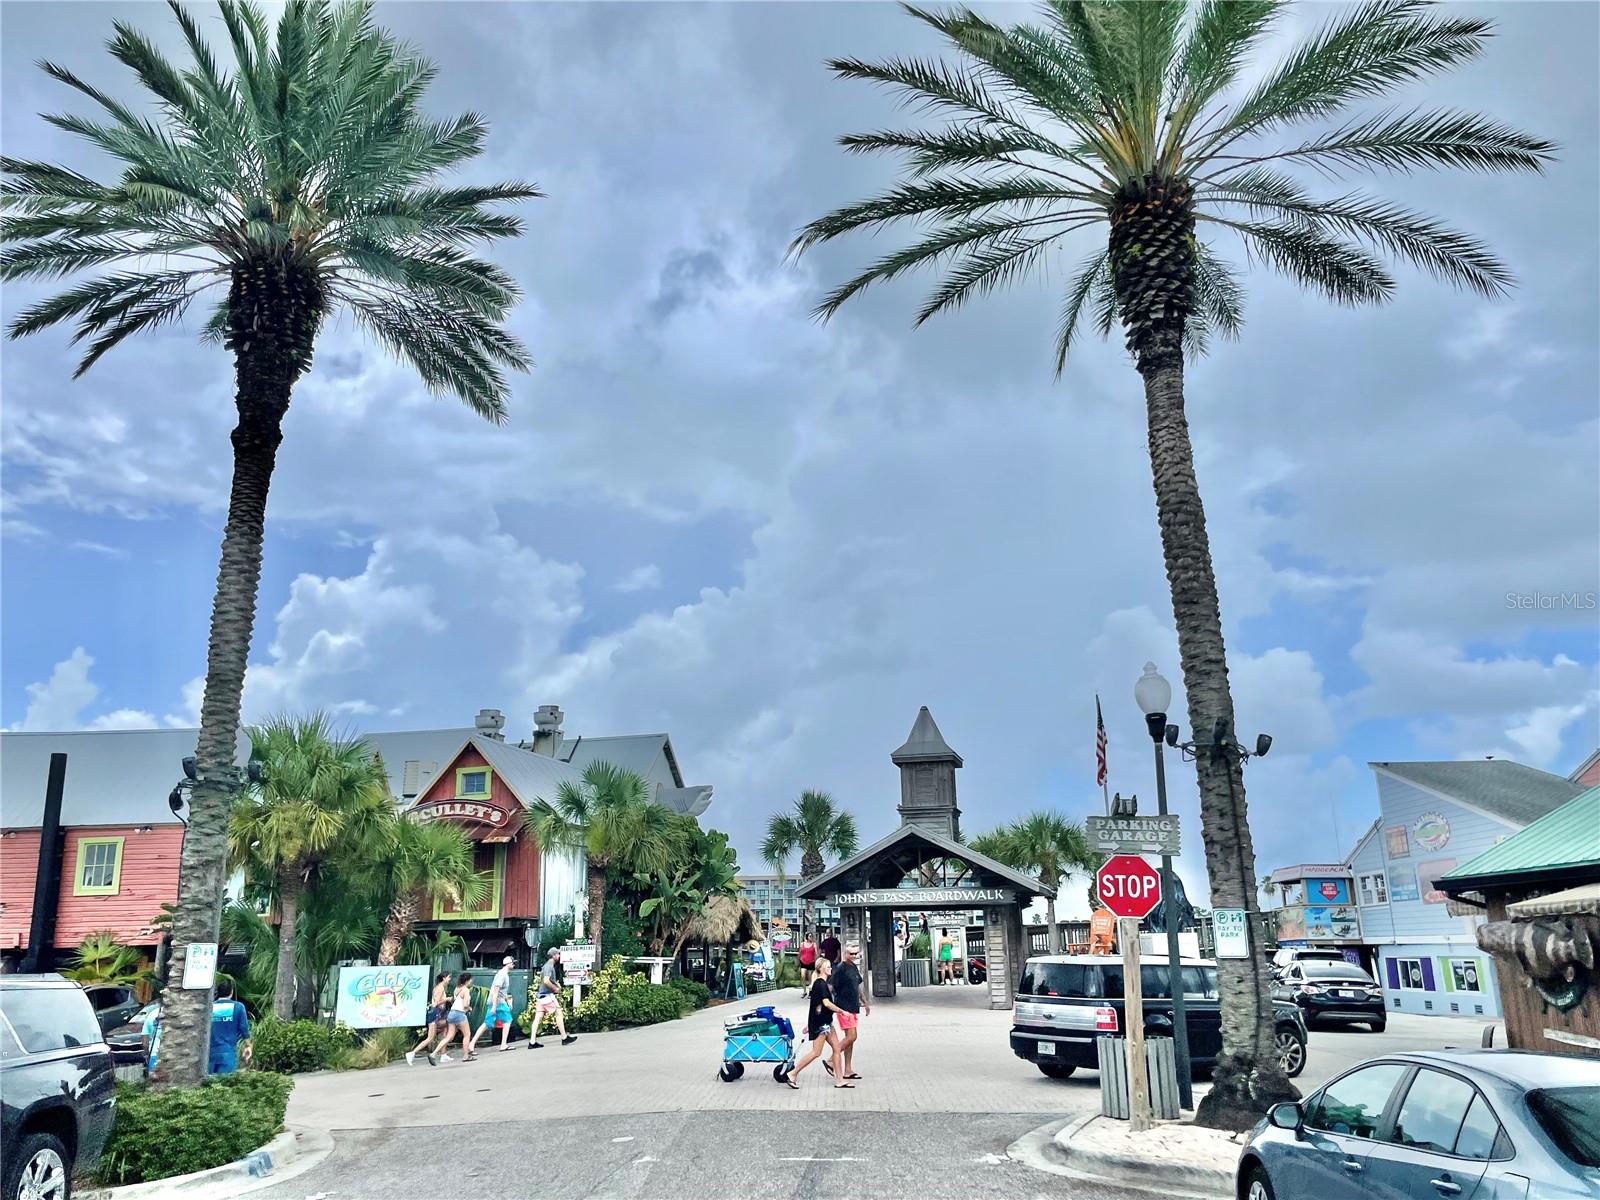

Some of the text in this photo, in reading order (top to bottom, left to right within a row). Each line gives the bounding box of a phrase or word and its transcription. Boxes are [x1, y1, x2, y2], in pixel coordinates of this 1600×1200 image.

[1096, 820, 1174, 831] PARKING
[1098, 831, 1169, 841] GARAGE
[1102, 874, 1156, 898] STOP
[835, 889, 1004, 905] JOHN'S PASS BOARDWALK
